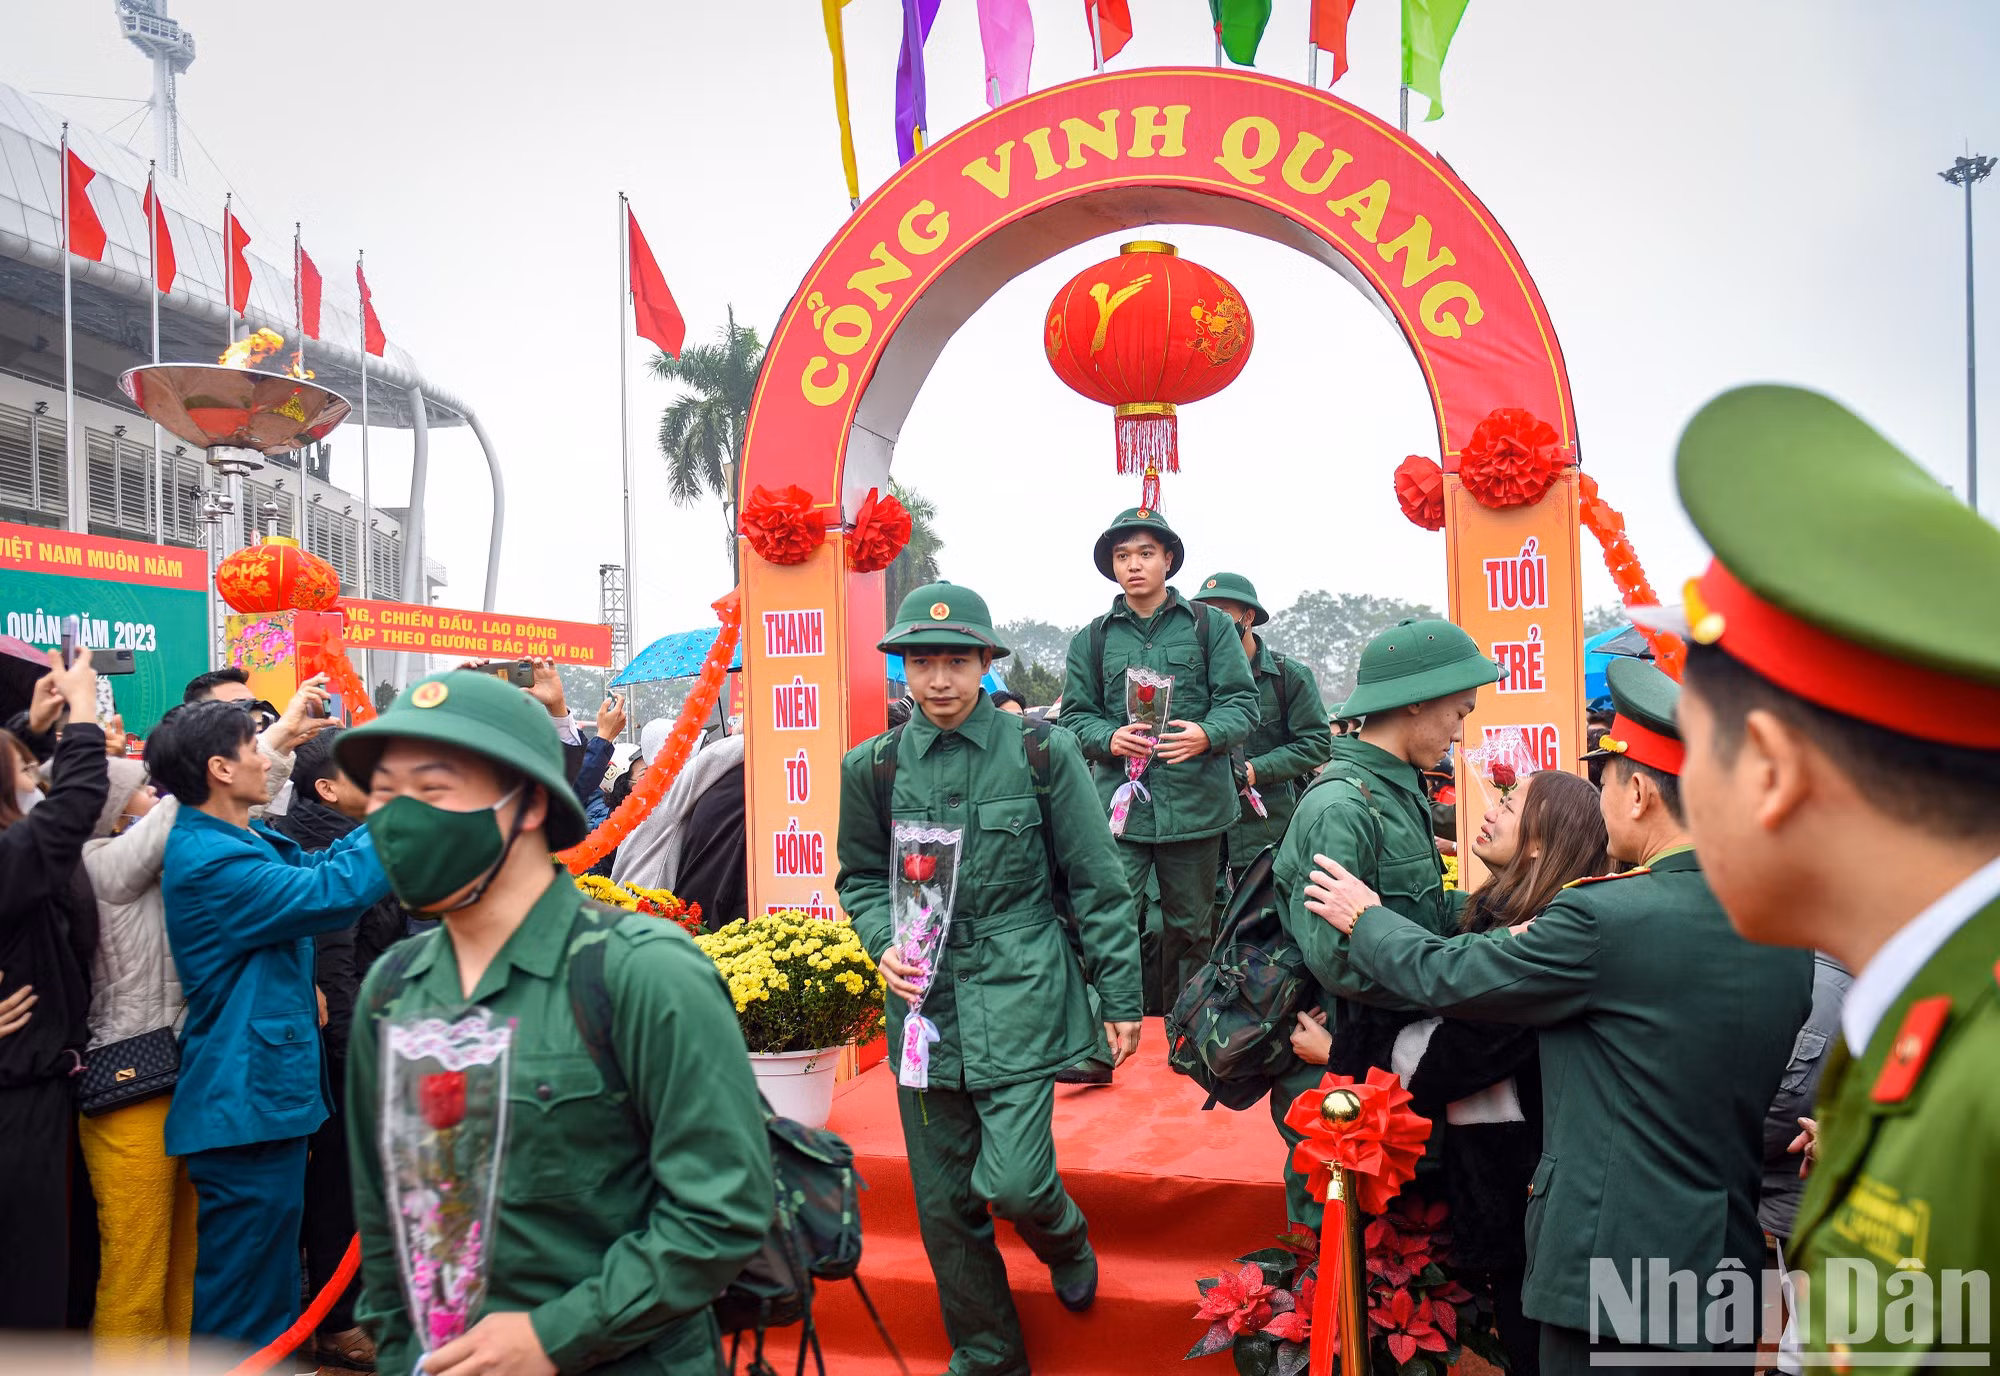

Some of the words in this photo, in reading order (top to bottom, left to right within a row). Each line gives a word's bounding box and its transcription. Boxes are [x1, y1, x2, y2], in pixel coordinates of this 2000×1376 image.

[801, 199, 950, 407] CỔNG
[962, 104, 1192, 200] VINH
[1213, 115, 1486, 340] QUANG
[38, 542, 82, 566] NAM
[87, 549, 140, 573] MUÔN
[144, 554, 183, 578] NĂM
[1486, 539, 1546, 608] TUỔI
[77, 611, 110, 649] ĂM
[114, 621, 157, 652] 2023
[380, 609, 434, 628] CHIẾN
[438, 613, 477, 634] ĐẤU,
[482, 620, 511, 636] LAO
[515, 622, 557, 641] ĐỘNG
[381, 629, 425, 646] THEO
[430, 633, 488, 652] GƯƠNG
[492, 636, 523, 655] BÁC
[528, 638, 549, 657] HỒ
[552, 643, 567, 657] VĨ
[570, 646, 595, 662] ĐẠI
[764, 611, 823, 656] THANH
[1494, 627, 1542, 690] TRẺ
[775, 677, 817, 728] NIÊN
[786, 751, 808, 801] TÔ
[775, 819, 823, 875] HỒNG
